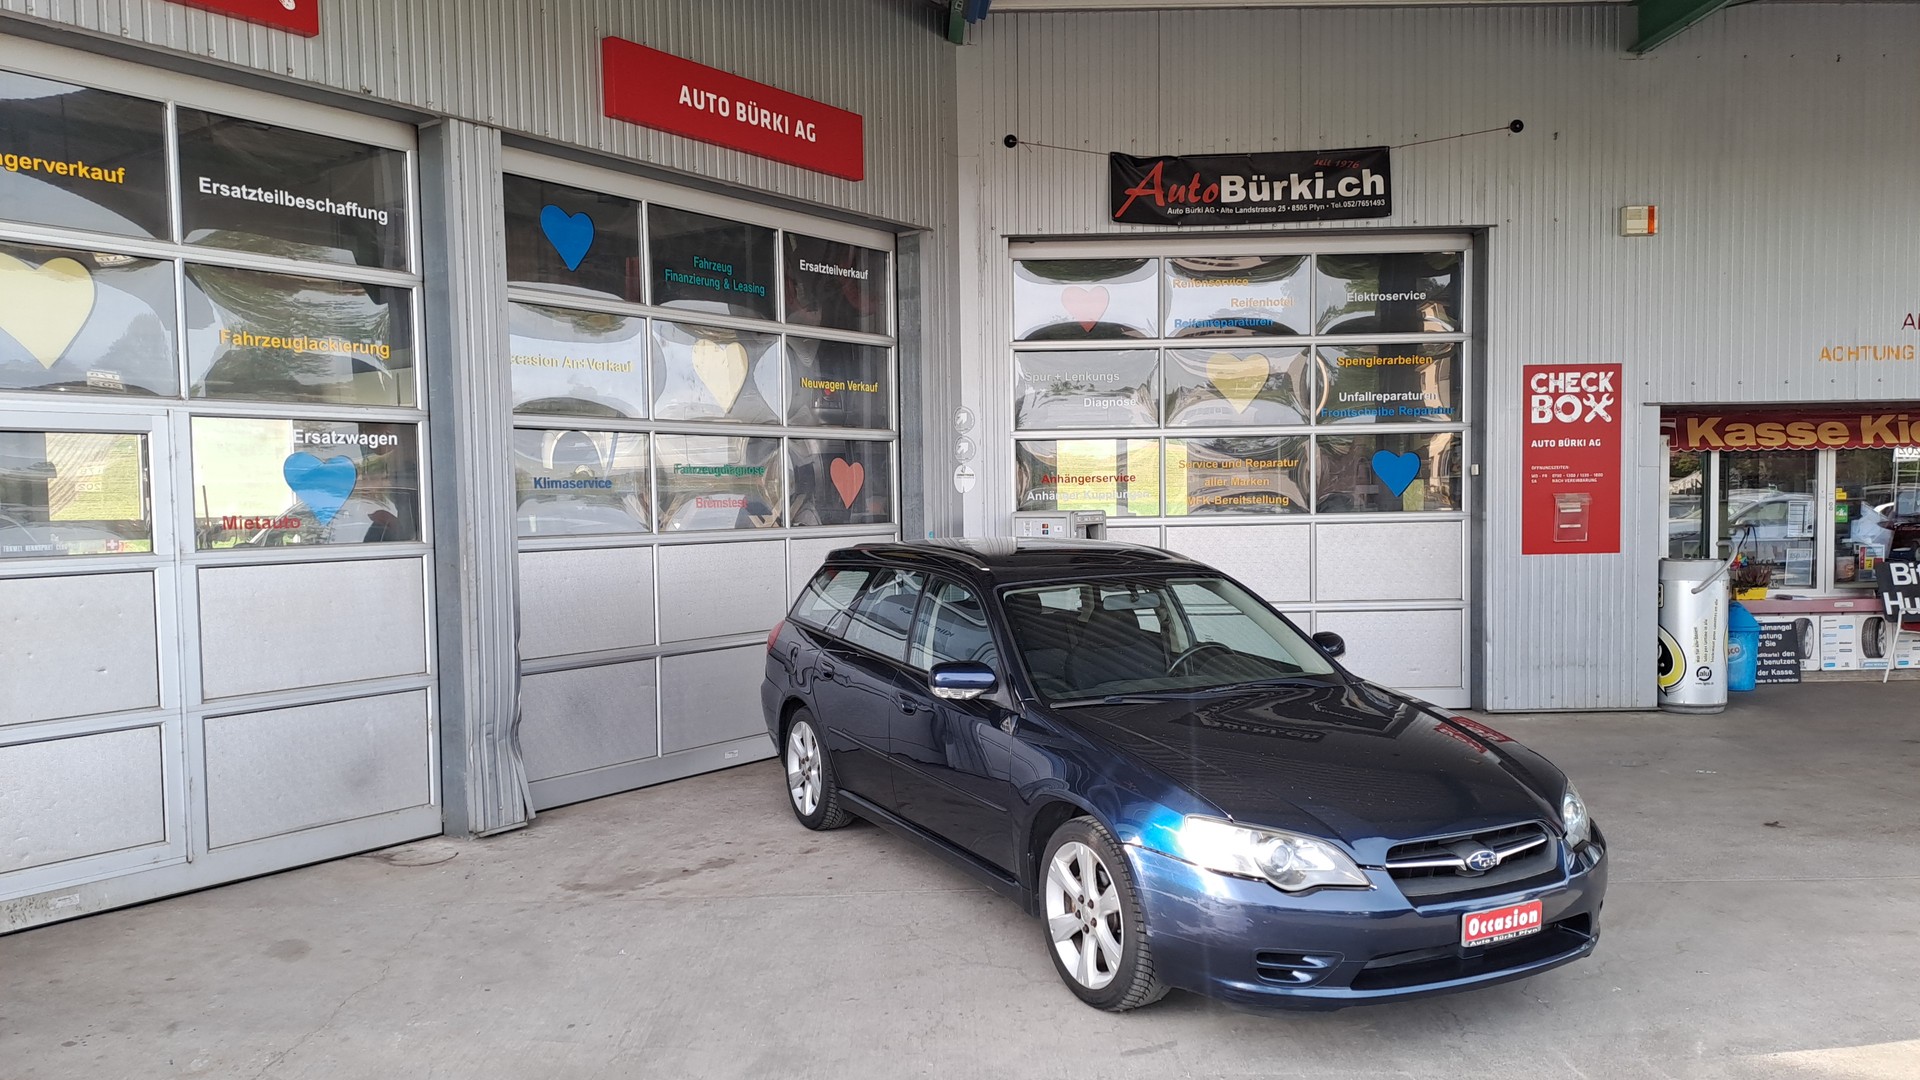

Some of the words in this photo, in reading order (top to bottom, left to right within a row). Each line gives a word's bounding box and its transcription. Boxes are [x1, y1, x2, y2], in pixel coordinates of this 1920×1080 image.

[679, 85, 730, 118] AUTO
[736, 101, 790, 135] BÜRKI
[795, 119, 817, 142] AG
[0, 153, 125, 184] gerverkauf
[1336, 158, 1360, 169] 1976
[199, 176, 389, 226] Ersatzteilbeschaffung
[1167, 206, 1184, 215] Auto
[1185, 206, 1203, 214] Bürki
[1220, 206, 1234, 214] Alte
[1235, 205, 1276, 214] Landstrasse
[1291, 203, 1308, 211] 8505
[1309, 203, 1325, 211] Pfyn
[693, 255, 733, 276] Fahrzeug
[799, 259, 869, 281] Ersatzteilverkauf
[665, 269, 721, 292] Finanzierung
[723, 279, 731, 290] &
[732, 279, 766, 296] Leasing
[1173, 277, 1249, 288] Reifenservice
[1230, 297, 1293, 308] Reifenhotel
[1347, 291, 1427, 303] Elektroservice
[1174, 317, 1273, 330] Reifenreparaturen
[219, 329, 391, 360] Fahrzeuglackierung
[1818, 344, 1915, 362] ACHTUNG
[1337, 355, 1434, 368] Spenglerarbeiten
[1024, 372, 1052, 385] Spur
[1064, 371, 1120, 384] Lenkungs
[1530, 371, 1615, 393] CHECK
[801, 377, 846, 393] Neuwagen
[847, 379, 879, 394] Verkauf
[1083, 397, 1138, 410] Diagnose
[1338, 390, 1437, 404] Unfallreparaturen
[1321, 406, 1395, 418] Frontscheibe
[1398, 405, 1455, 418] Reparatur
[1531, 393, 1614, 424] BOX
[293, 429, 398, 447] Ersatzwagen
[1686, 417, 1850, 447] Kasse
[1531, 439, 1556, 448] AUTO
[1558, 437, 1586, 447] BÜRKI
[1588, 438, 1601, 447] AG
[673, 462, 765, 478] Fahrzeugdiagnose
[1178, 460, 1219, 470] Service
[1222, 459, 1242, 469] und
[1245, 457, 1299, 470] Reparatur
[533, 476, 613, 490] Klimaservice
[1041, 472, 1137, 486] Anhängerservice
[1204, 476, 1228, 487] aller
[1231, 476, 1270, 487] Marken
[1027, 489, 1079, 502] Anhänger
[1083, 488, 1150, 502] Kupplungen
[1187, 494, 1289, 508] MFK-Bereitstellung
[695, 497, 747, 509] Bremstest
[222, 515, 301, 531] Mietauto
[1761, 624, 1792, 632] almangel
[1468, 907, 1538, 937] Occasion
[1469, 938, 1490, 947] Auto
[1493, 932, 1517, 942] Bürki
[1519, 928, 1539, 936] Pfyn
